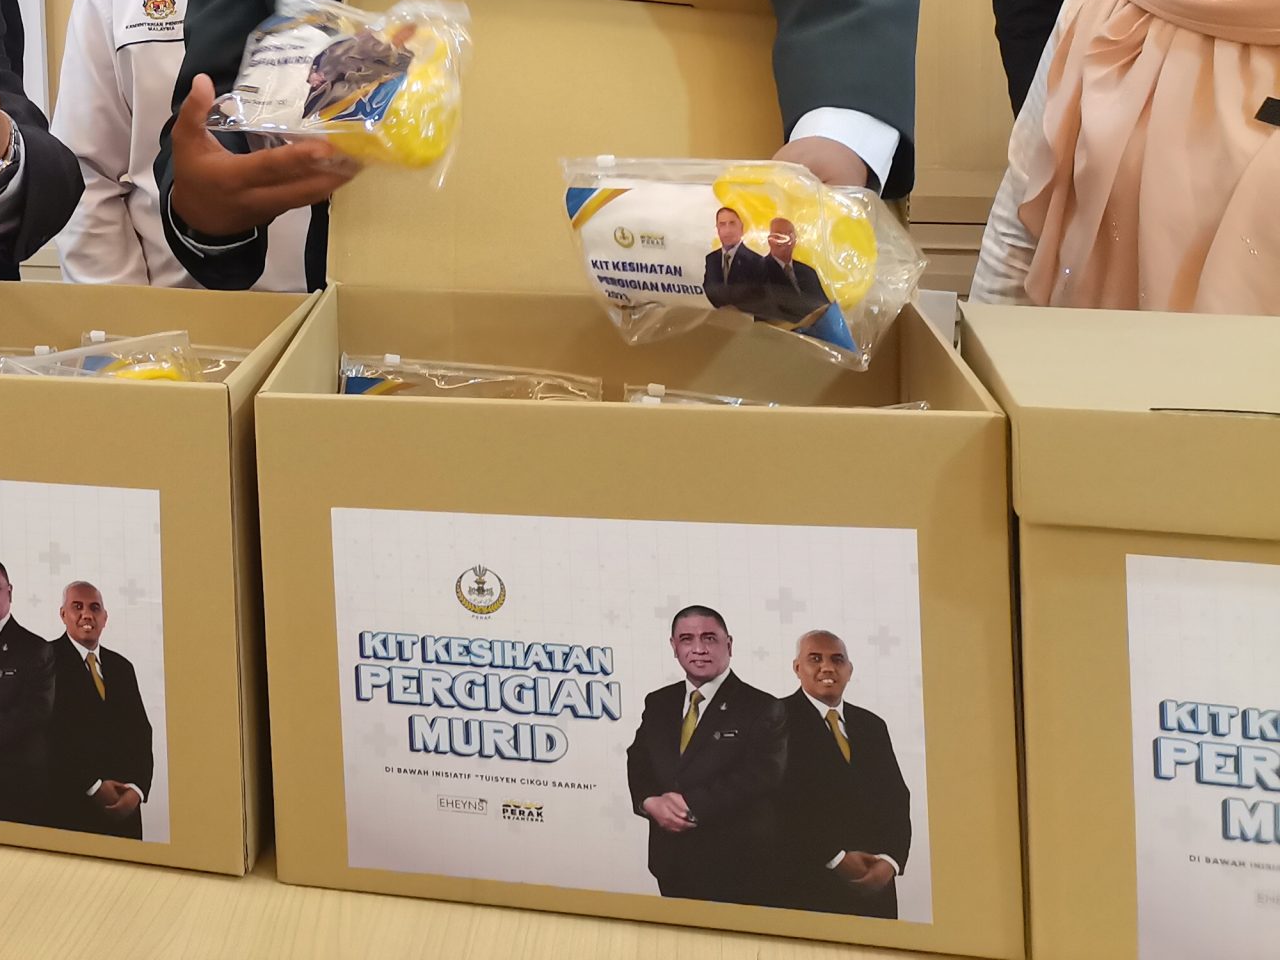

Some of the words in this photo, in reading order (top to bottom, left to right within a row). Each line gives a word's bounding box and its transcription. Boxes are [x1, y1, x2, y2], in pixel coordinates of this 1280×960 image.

[592, 260, 610, 270] KIT
[612, 261, 682, 277] KESIHATAN
[597, 275, 659, 292] PERGIGIAN
[662, 283, 703, 295] MURID
[358, 631, 419, 660] KIT
[421, 635, 614, 675] KESIHATAN
[355, 664, 622, 720] PERGIGIAN
[1159, 699, 1239, 737] KIT
[408, 714, 569, 762] MURID
[1152, 736, 1280, 792] PER
[397, 768, 429, 776] BAWAH
[432, 771, 471, 780] INISIATIF
[475, 774, 517, 784] "TUISYEN
[520, 778, 549, 787] CIKGU
[552, 781, 597, 790] SAARANI"
[440, 798, 484, 811] EHEYNS
[502, 808, 543, 817] PERAK
[1189, 854, 1200, 862] DI
[1204, 856, 1246, 867] BAWAH
